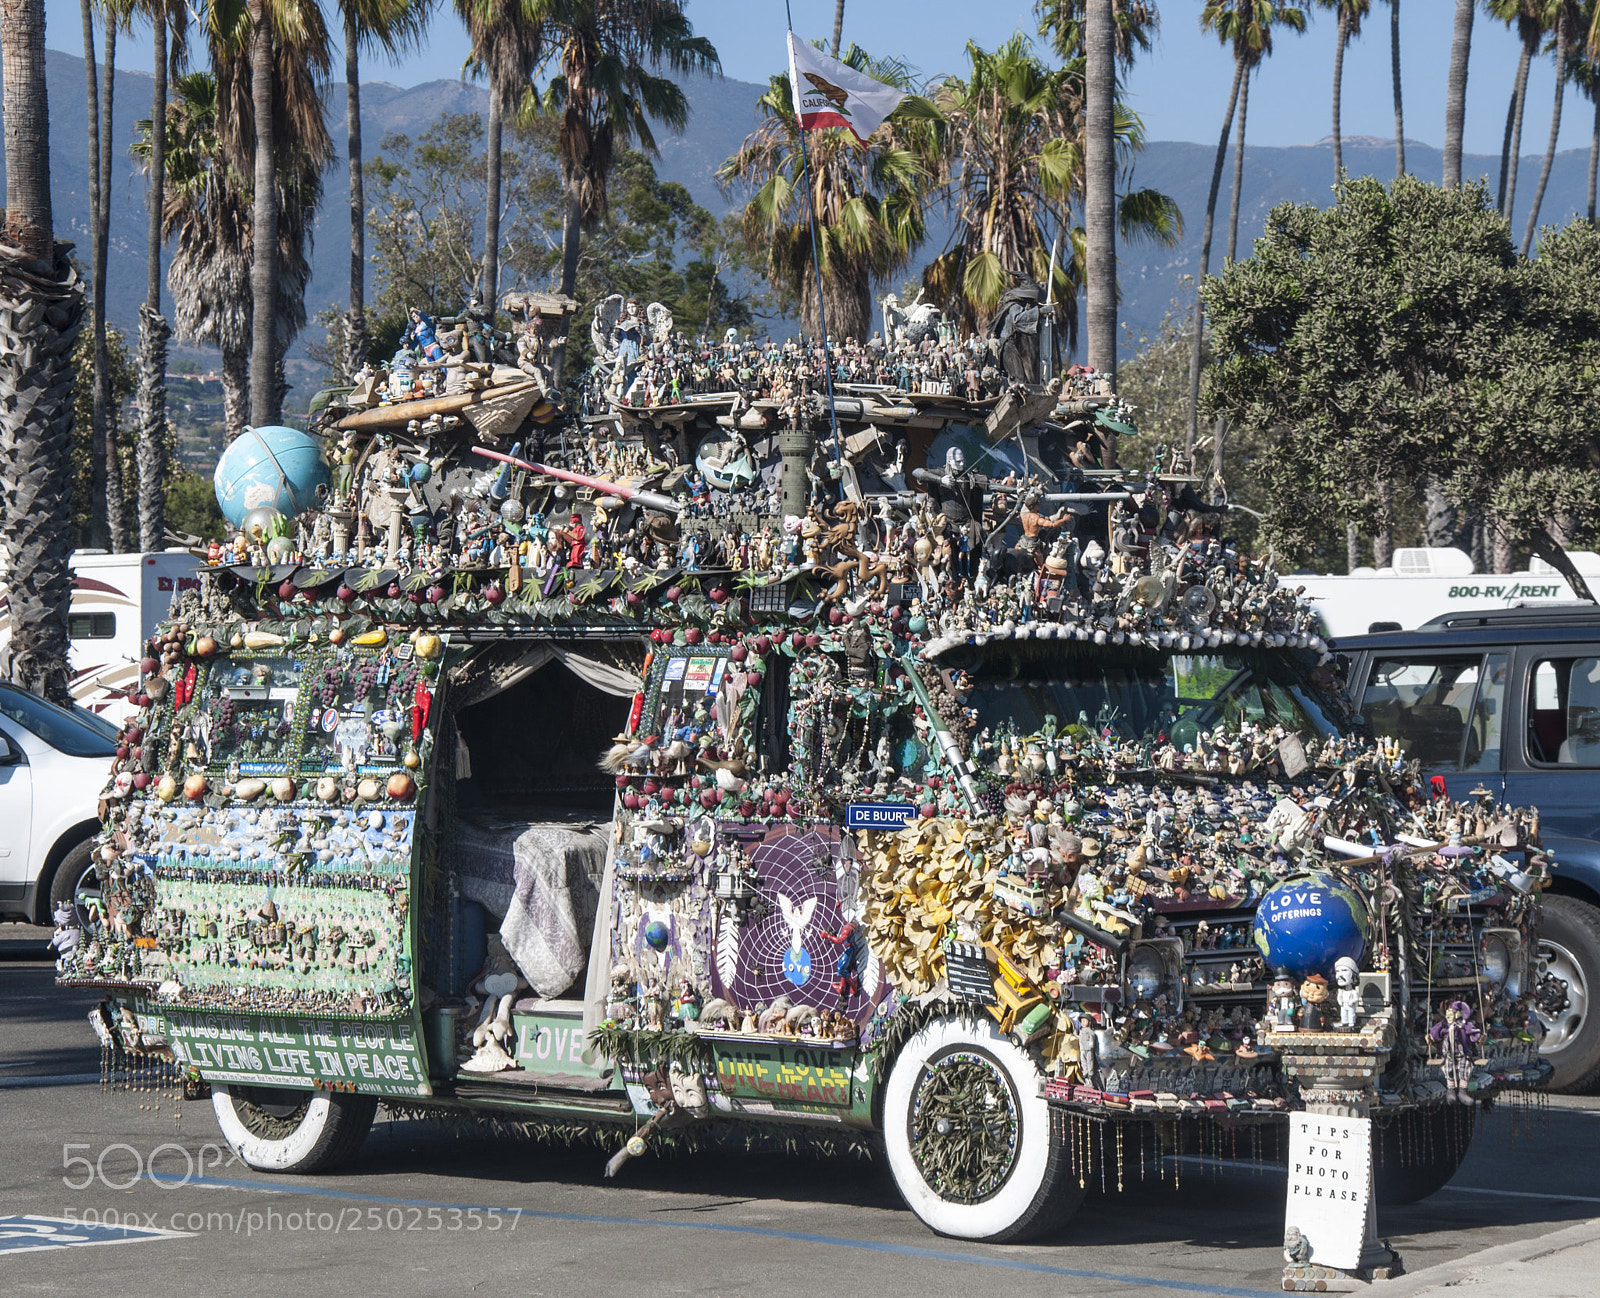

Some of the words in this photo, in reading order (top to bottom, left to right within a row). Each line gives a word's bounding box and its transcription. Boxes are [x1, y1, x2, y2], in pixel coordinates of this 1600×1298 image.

[802, 98, 830, 108] CALIFO
[921, 381, 950, 395] LOVE
[178, 577, 201, 591] MO
[856, 810, 870, 821] DE
[873, 811, 909, 822] BUURT
[1270, 893, 1322, 911] LOVE
[1271, 908, 1322, 922] OFFERINGS
[166, 1012, 254, 1041] IMAGINE
[259, 1017, 296, 1045] ALL
[298, 1020, 337, 1047] THE
[339, 1022, 415, 1051] PEOPLE
[520, 1025, 584, 1063] LOVE
[184, 1042, 263, 1071] LIVING
[263, 1047, 316, 1075] LIFE
[314, 1051, 346, 1077] IN
[718, 1050, 775, 1094] ONE
[779, 1047, 844, 1079] LOVE
[357, 1082, 383, 1093] JOHN
[385, 1085, 419, 1096] LENNO
[776, 1073, 849, 1105] HEART
[1301, 1124, 1349, 1139] TIPS
[1309, 1146, 1342, 1160] FOR
[1295, 1163, 1349, 1180] PHOTO
[1293, 1185, 1358, 1201] PLEASE
